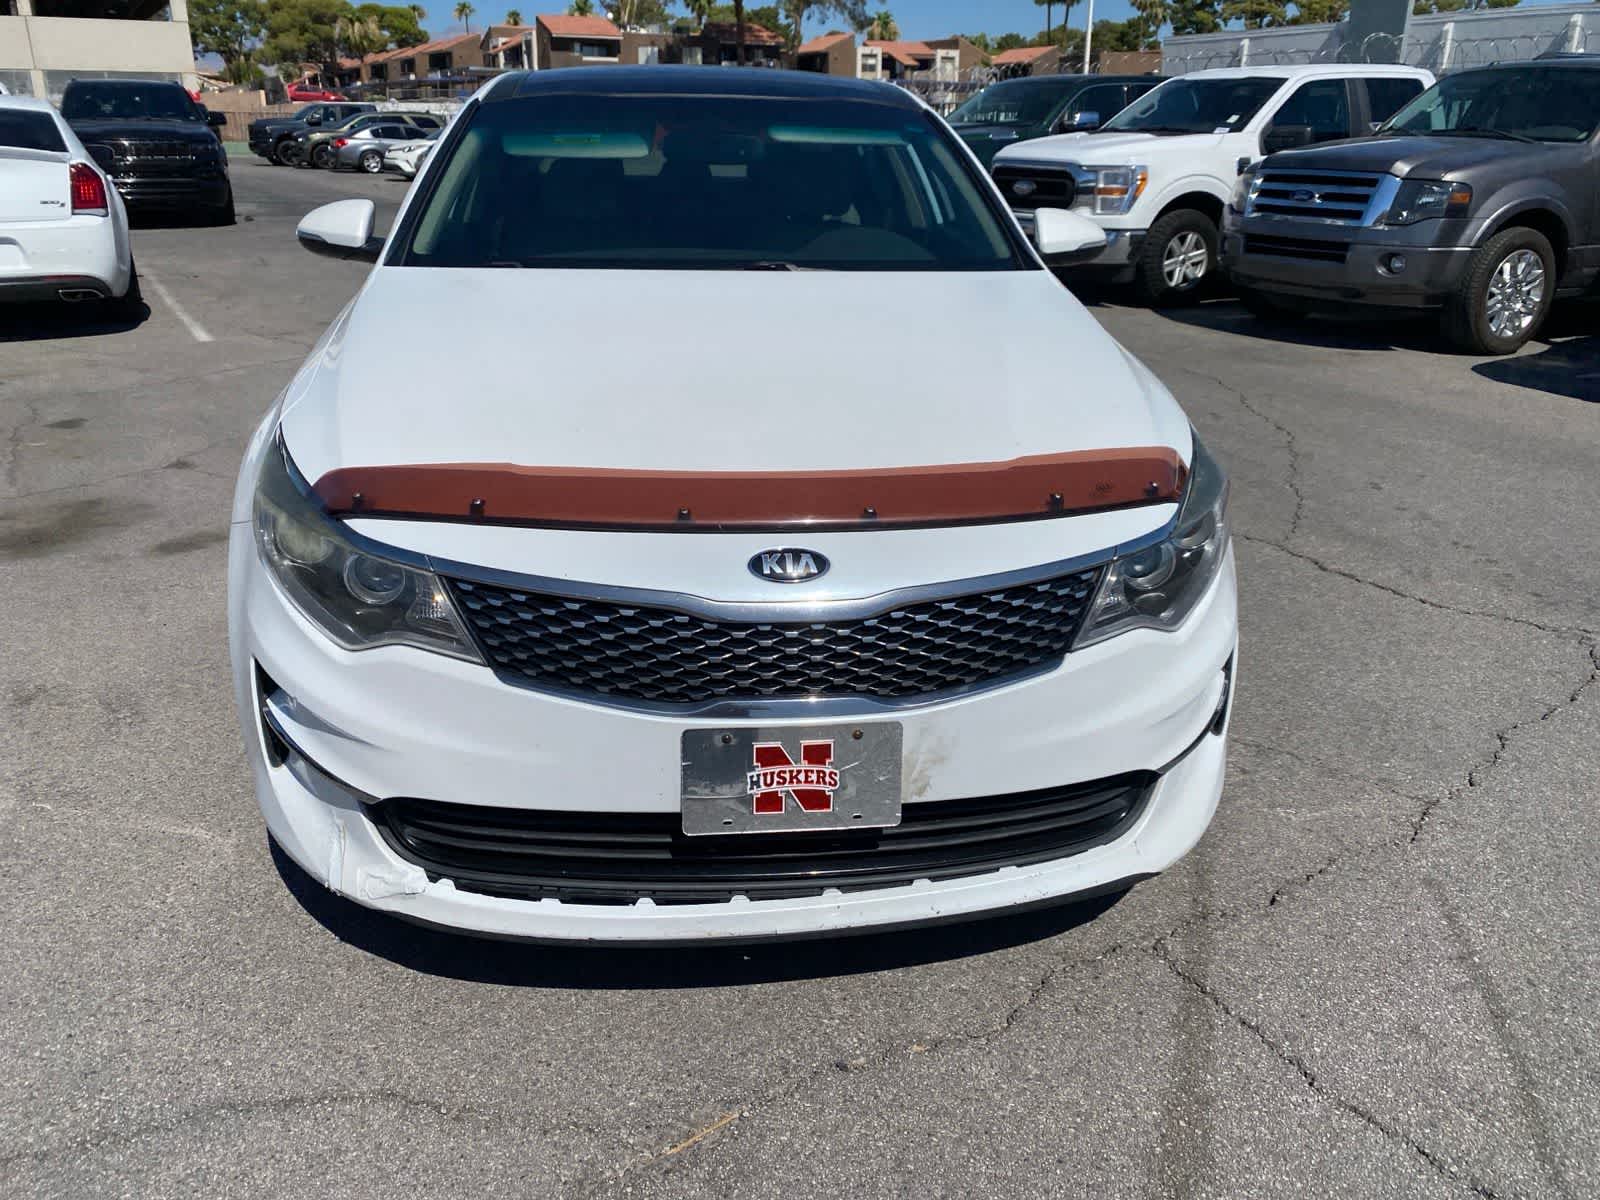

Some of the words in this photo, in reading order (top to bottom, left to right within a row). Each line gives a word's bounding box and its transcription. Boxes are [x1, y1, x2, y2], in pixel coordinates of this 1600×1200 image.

[761, 553, 818, 574] KIA
[747, 768, 839, 791] HUSKERS
[752, 739, 834, 814] N
